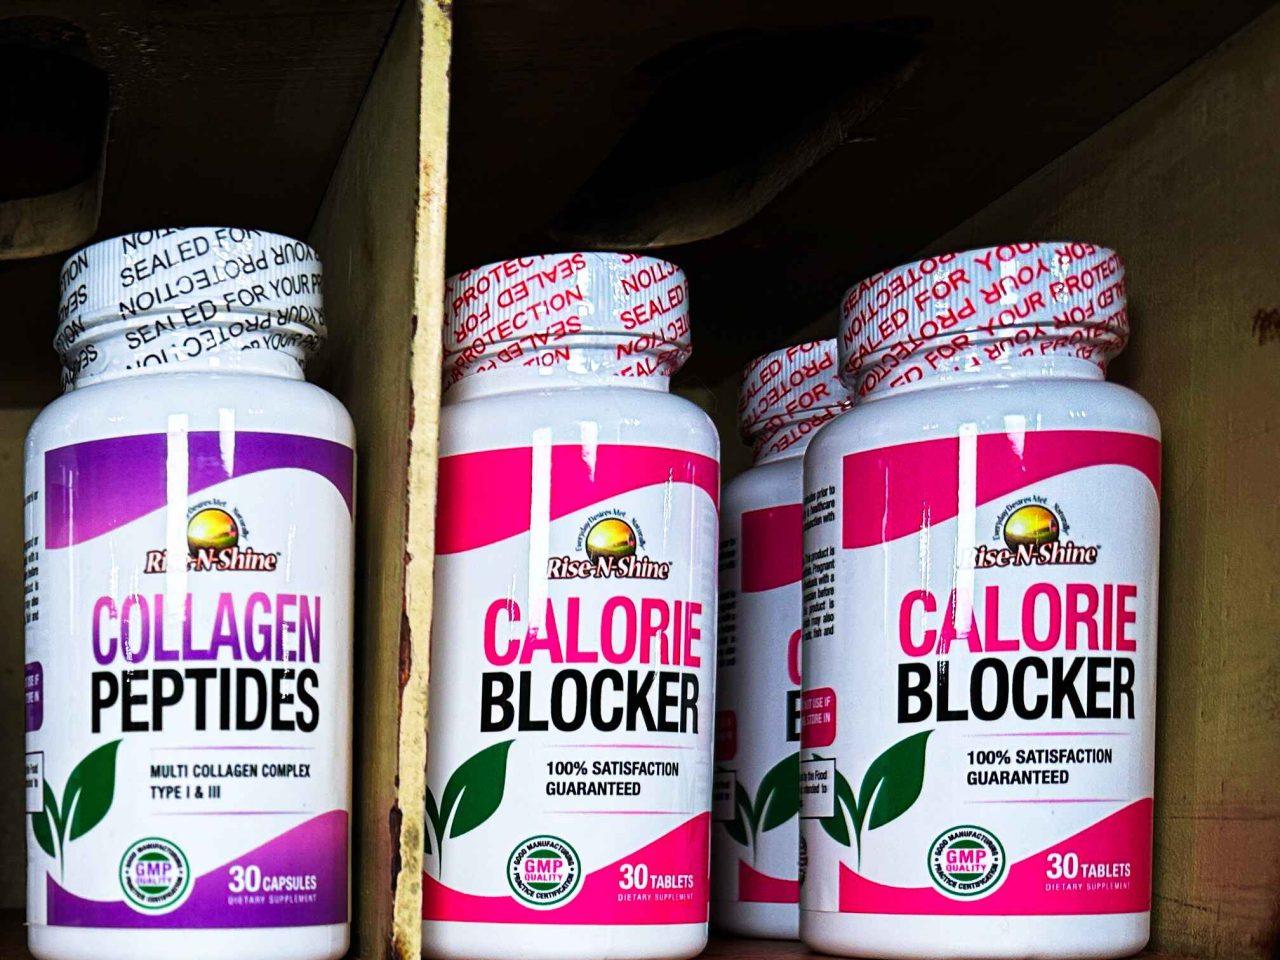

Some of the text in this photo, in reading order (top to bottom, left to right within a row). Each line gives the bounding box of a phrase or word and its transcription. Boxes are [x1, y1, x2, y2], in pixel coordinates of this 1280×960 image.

[120, 234, 211, 287] SEALED
[223, 273, 311, 313] FOR YOUR
[496, 253, 587, 308] SEALED
[916, 269, 970, 309] FOR
[978, 290, 1045, 336] YOUR
[547, 554, 670, 580] Rise-N-Shine
[92, 592, 320, 665] COLLAGEN
[484, 596, 703, 668] CALORIE
[898, 583, 1137, 657] CALORIE
[91, 667, 319, 734] PEPTIDES
[480, 669, 699, 734] BLOCKER
[897, 656, 1136, 724] BLOCKER
[547, 761, 679, 776] 100% SATISFACTION
[967, 748, 1112, 766] 100% SATISFACTION
[150, 764, 310, 778] MULTI COLLAGEN COMPLEX
[966, 770, 1070, 786] GUARANTEED
[546, 782, 641, 796] GUARANTEED
[525, 859, 563, 873] GMP
[946, 849, 987, 863] GMP
[946, 863, 987, 873] QUALITY
[1046, 852, 1131, 880] 30 TABLETS
[228, 865, 317, 892] 30 CAPSULES
[524, 873, 563, 882] QUALITY
[619, 863, 694, 890] 30 TABLETS
[618, 892, 693, 902] DIETARY SUPPLEMENT
